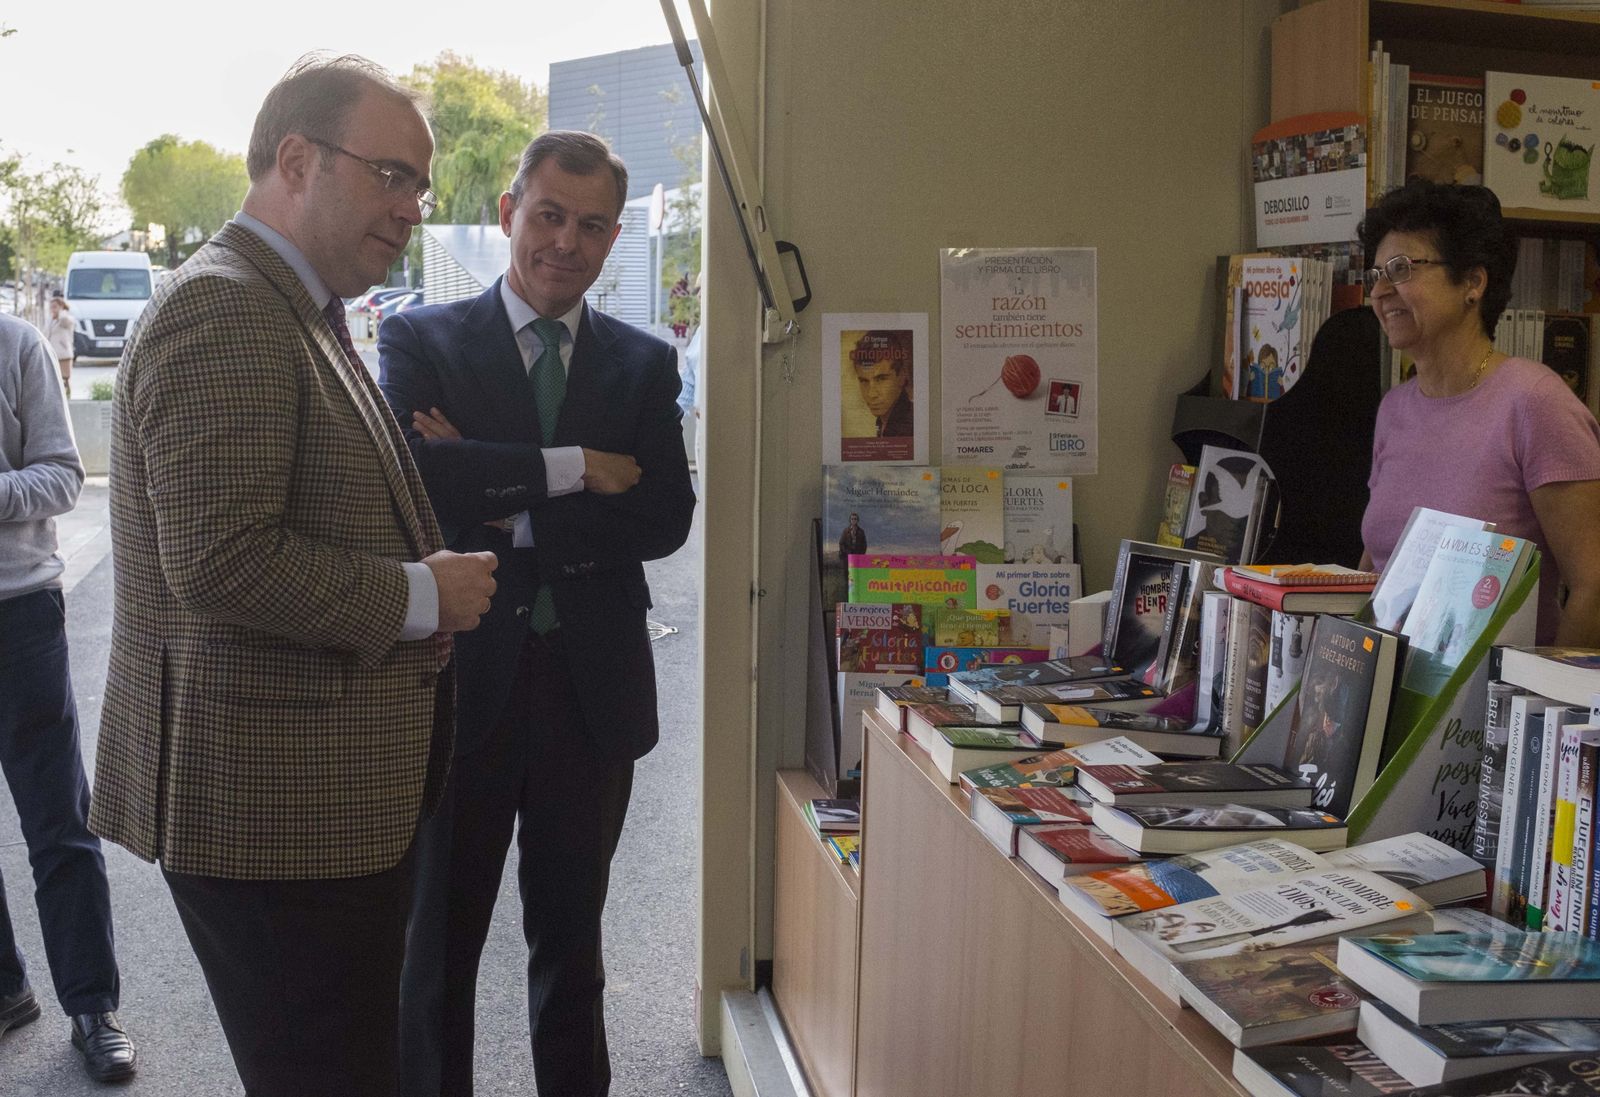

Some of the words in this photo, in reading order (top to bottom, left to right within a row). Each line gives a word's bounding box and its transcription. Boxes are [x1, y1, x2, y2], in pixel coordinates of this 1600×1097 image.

[1417, 89, 1432, 103] EL
[1437, 90, 1483, 107] JUEGO
[1411, 107, 1428, 120] DE
[1264, 195, 1310, 215] DEBOLSILLO
[986, 266, 1013, 274] FIRMA
[1034, 265, 1061, 273] LIBRO
[1014, 286, 1025, 296] La
[992, 295, 1046, 310] razón
[1027, 312, 1047, 321] tiene
[955, 321, 1083, 338] sentimientos
[956, 445, 994, 454] TOMARES
[1049, 433, 1085, 452] LIBRO
[846, 486, 874, 497] Miguel
[961, 484, 989, 493] LOCA
[1441, 537, 1450, 550] LA
[1451, 539, 1468, 553] VIDA
[1469, 542, 1482, 556] ES
[1007, 571, 1030, 580] primer
[1019, 581, 1070, 597] Gloria
[844, 603, 858, 613] Los
[860, 605, 890, 615] mejores
[1008, 598, 1070, 614] Fuertes
[1164, 600, 1174, 632] DANIEL
[1170, 572, 1180, 597] SILVA
[848, 615, 891, 627] VERSOS
[872, 632, 918, 648] Gloria
[1330, 633, 1356, 654] ARTURO
[862, 646, 918, 663] Fuertes
[1486, 698, 1498, 750] BRUCE
[1561, 741, 1579, 761] you
[1506, 757, 1517, 797] GENER
[1541, 763, 1549, 793] BONA
[1475, 755, 1494, 856] SPRINGSTEEN
[1580, 797, 1591, 814] EL
[1575, 817, 1590, 871] JUEGO
[1333, 877, 1395, 911] HOMBRE
[1592, 869, 1600, 909] Bisotti
[1278, 886, 1325, 911] DIOS
[1551, 889, 1563, 919] love
